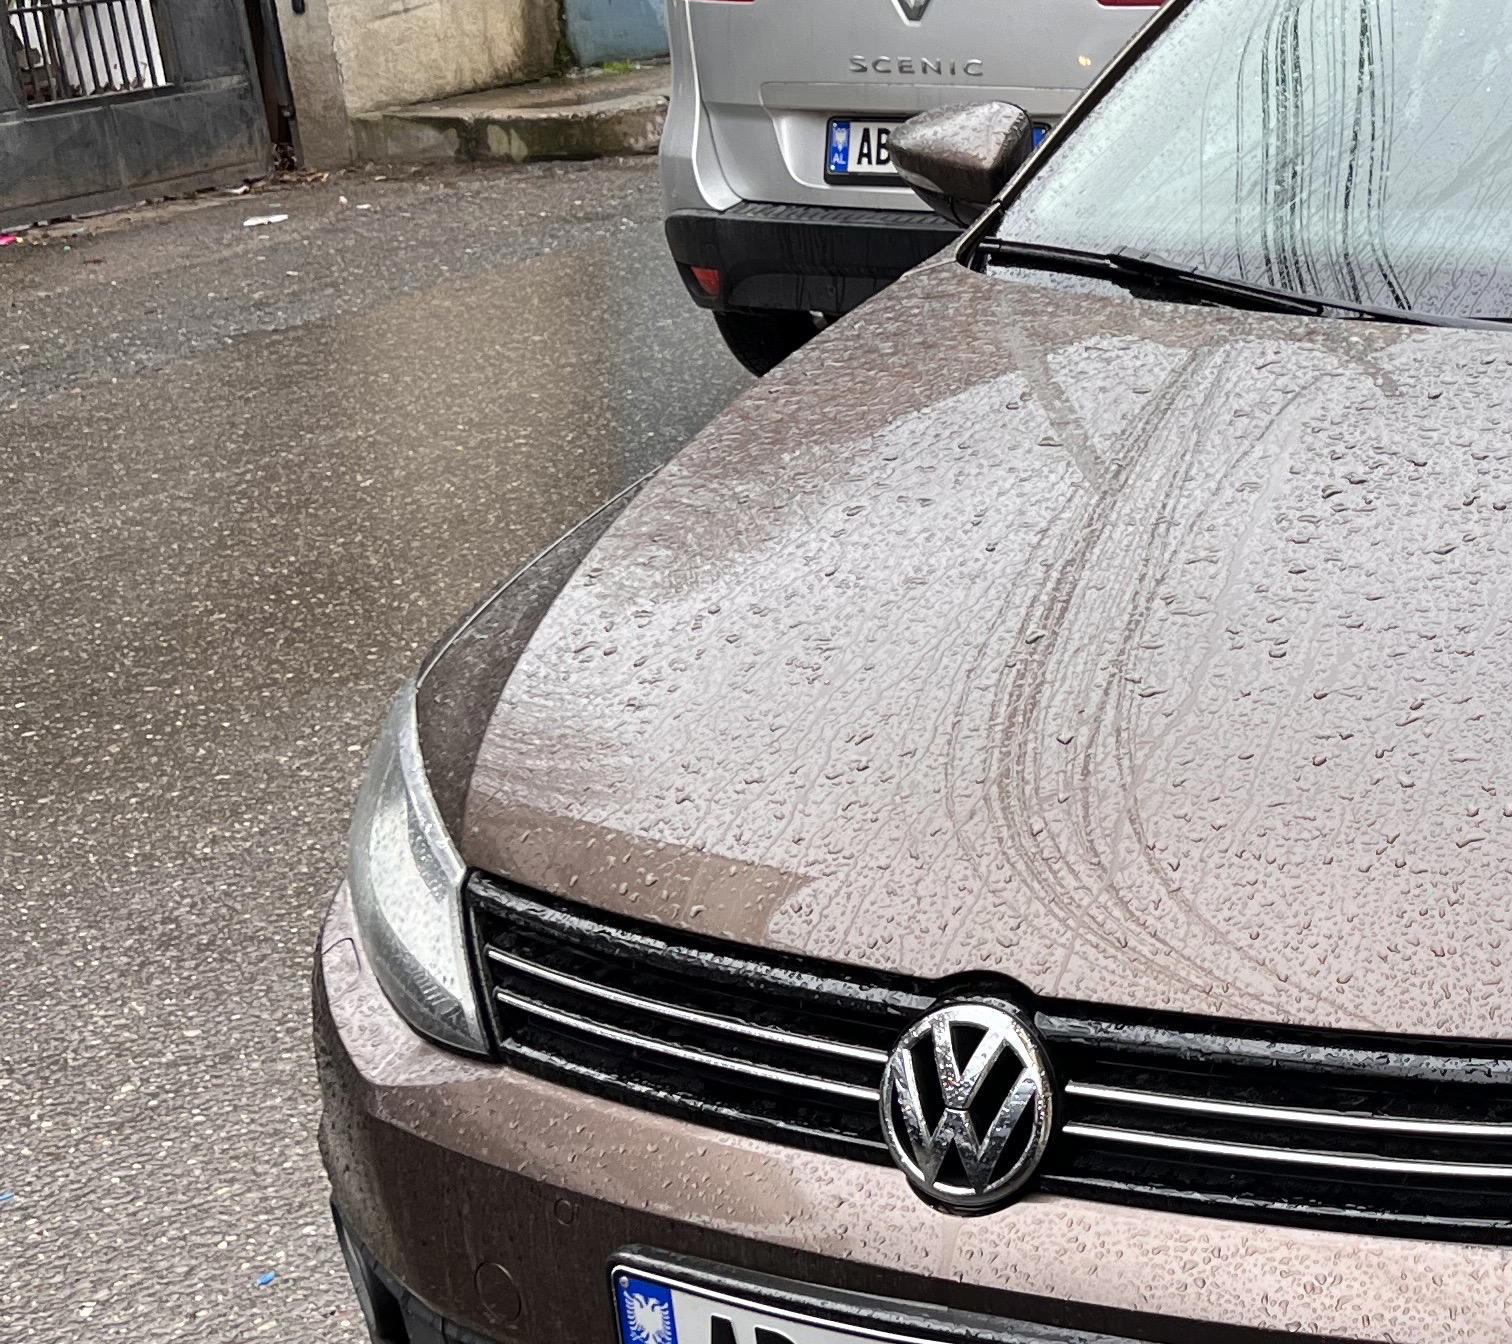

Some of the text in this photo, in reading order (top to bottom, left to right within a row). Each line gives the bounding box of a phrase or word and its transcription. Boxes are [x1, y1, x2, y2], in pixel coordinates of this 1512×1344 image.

[848, 54, 984, 77] SCENIC
[856, 127, 892, 166] AB
[832, 153, 847, 165] AL
